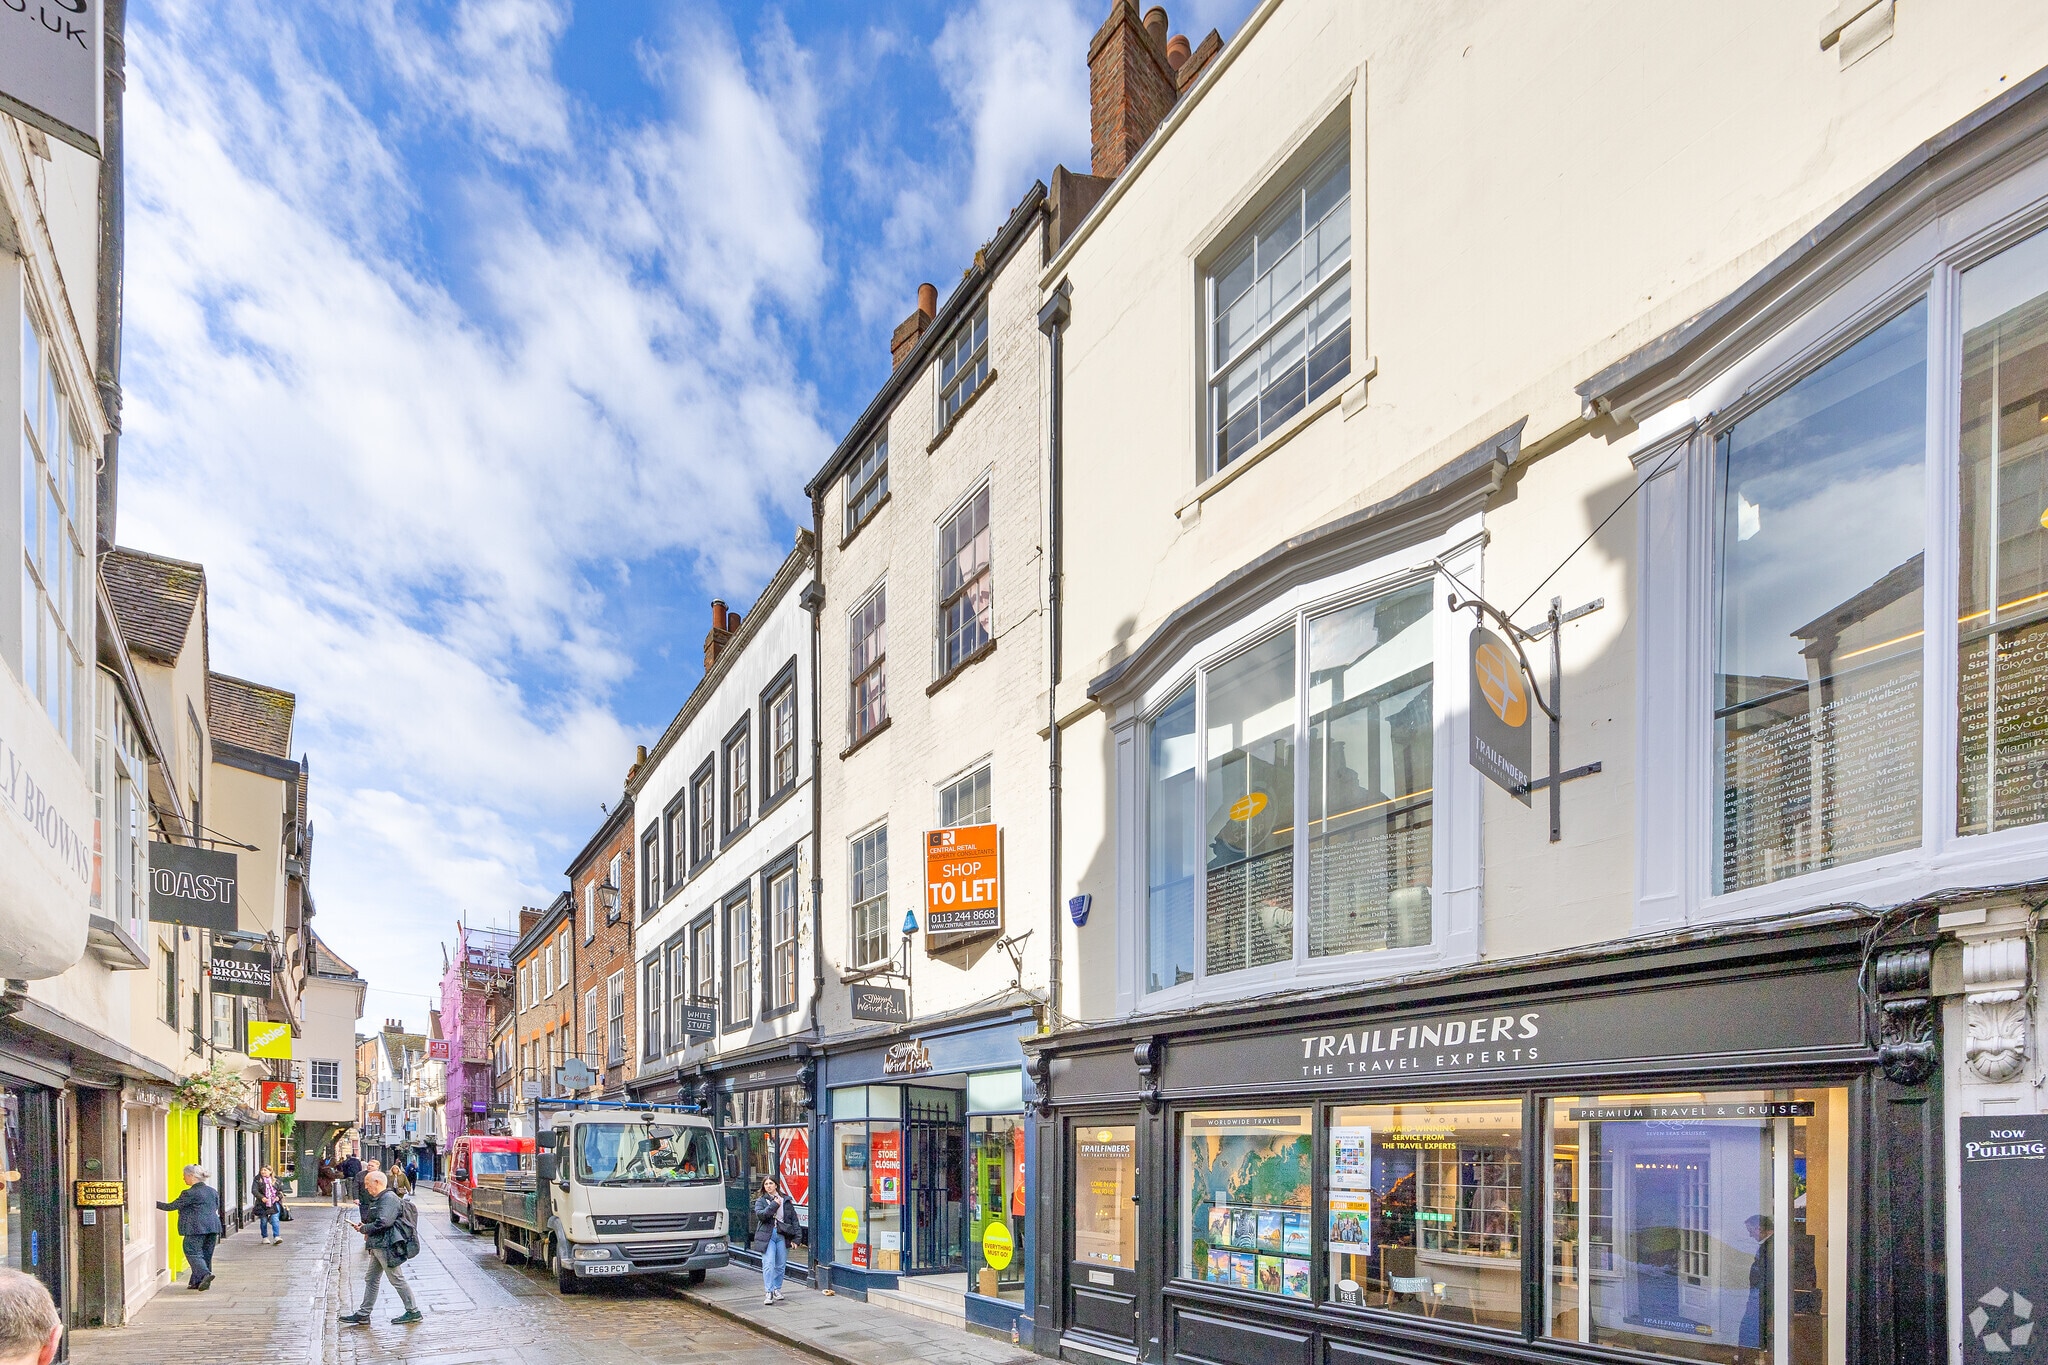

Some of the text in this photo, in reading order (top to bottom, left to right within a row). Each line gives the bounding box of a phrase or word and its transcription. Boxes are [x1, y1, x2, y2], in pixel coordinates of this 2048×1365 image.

[1475, 735, 1528, 787] TRAILFINDERS
[24, 771, 89, 884] BROWNS
[930, 846, 956, 854] CENTRAL
[943, 861, 981, 878] SHOP
[929, 878, 996, 906] TO LET
[931, 909, 995, 924] 0113 244 8668
[212, 958, 261, 971] MOLLY
[212, 967, 271, 982] BROWNS
[687, 1010, 711, 1020] WHITE
[687, 1021, 711, 1031] STUFF
[1301, 1013, 1540, 1059] TRAILFINDERS
[1302, 1047, 1538, 1076] THE TRAVEL EXPERTS
[1581, 1105, 1798, 1118] PREMIUM TRAVEL & CRUISE
[1990, 1130, 2026, 1138] NOW
[1081, 1144, 1130, 1153] TRAILFINDERS
[1424, 1142, 1456, 1150] EXPERTS
[1965, 1141, 2047, 1159] PULLING
[878, 1150, 897, 1159] STORE
[875, 1160, 900, 1170] CLOSING
[596, 1219, 628, 1227] DAF
[985, 1243, 1012, 1252] EVERYTHING
[987, 1249, 1008, 1258] MUST GO!
[588, 1264, 626, 1273] FE63 PCY
[1643, 1317, 1695, 1329] TRAILFINDERS
